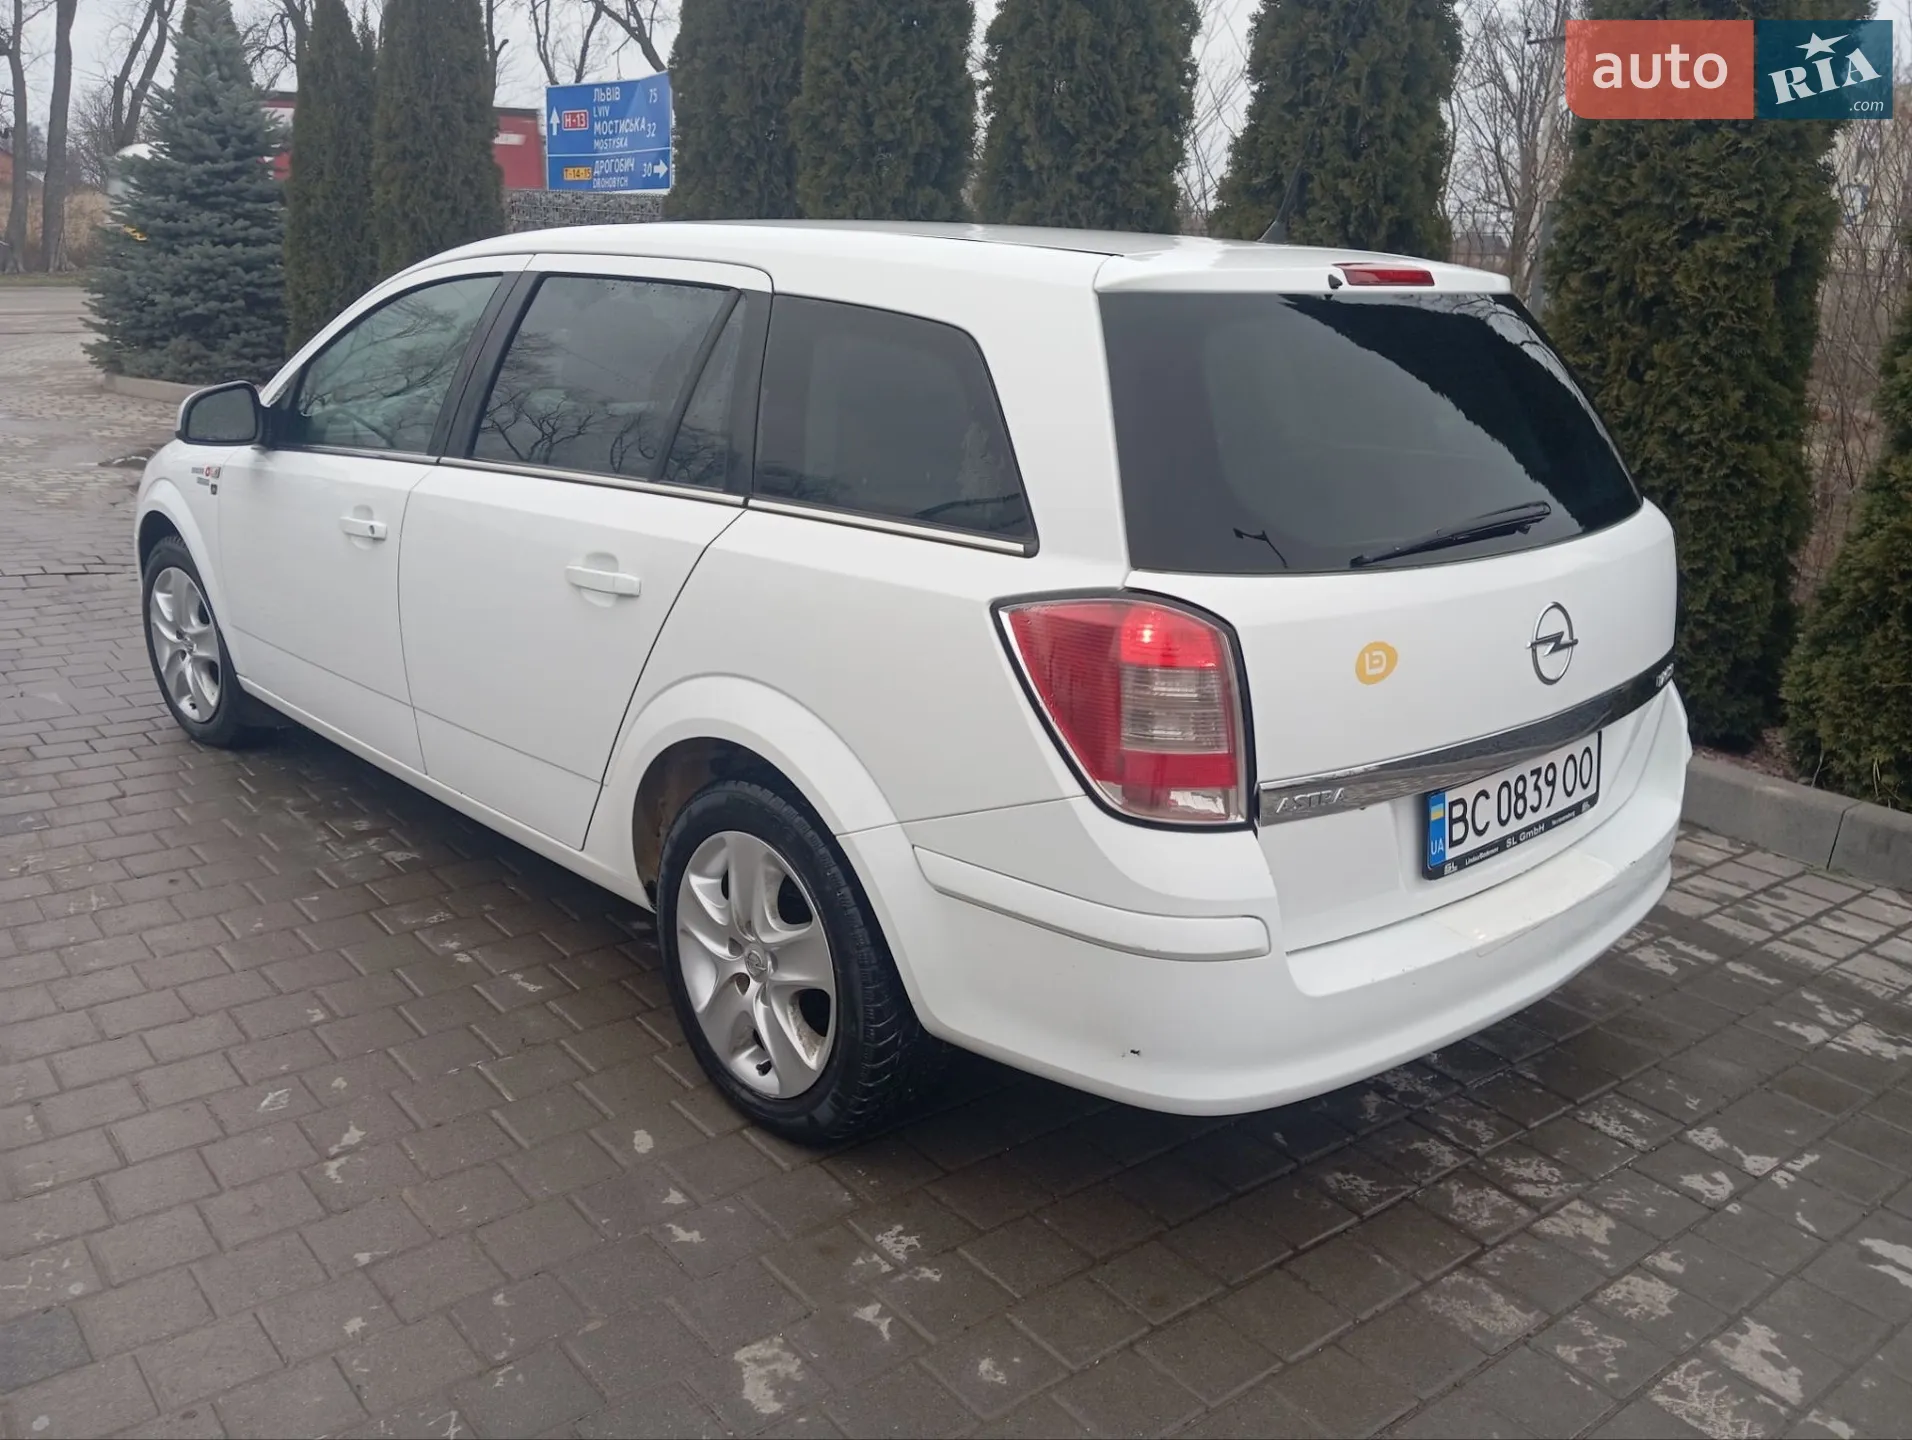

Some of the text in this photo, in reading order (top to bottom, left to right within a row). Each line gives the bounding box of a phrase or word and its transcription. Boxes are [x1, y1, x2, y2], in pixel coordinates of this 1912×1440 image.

[593, 86, 658, 103] ЛЬВІВ 75
[593, 106, 610, 118] LVIV
[593, 117, 657, 138] МОСТИСЬКА 32
[593, 137, 629, 150] MOSTYSKA
[593, 157, 652, 178] ДРОГОБИЧ 30
[1519, 823, 1545, 842] GmbH
[1430, 837, 1444, 855] UA
